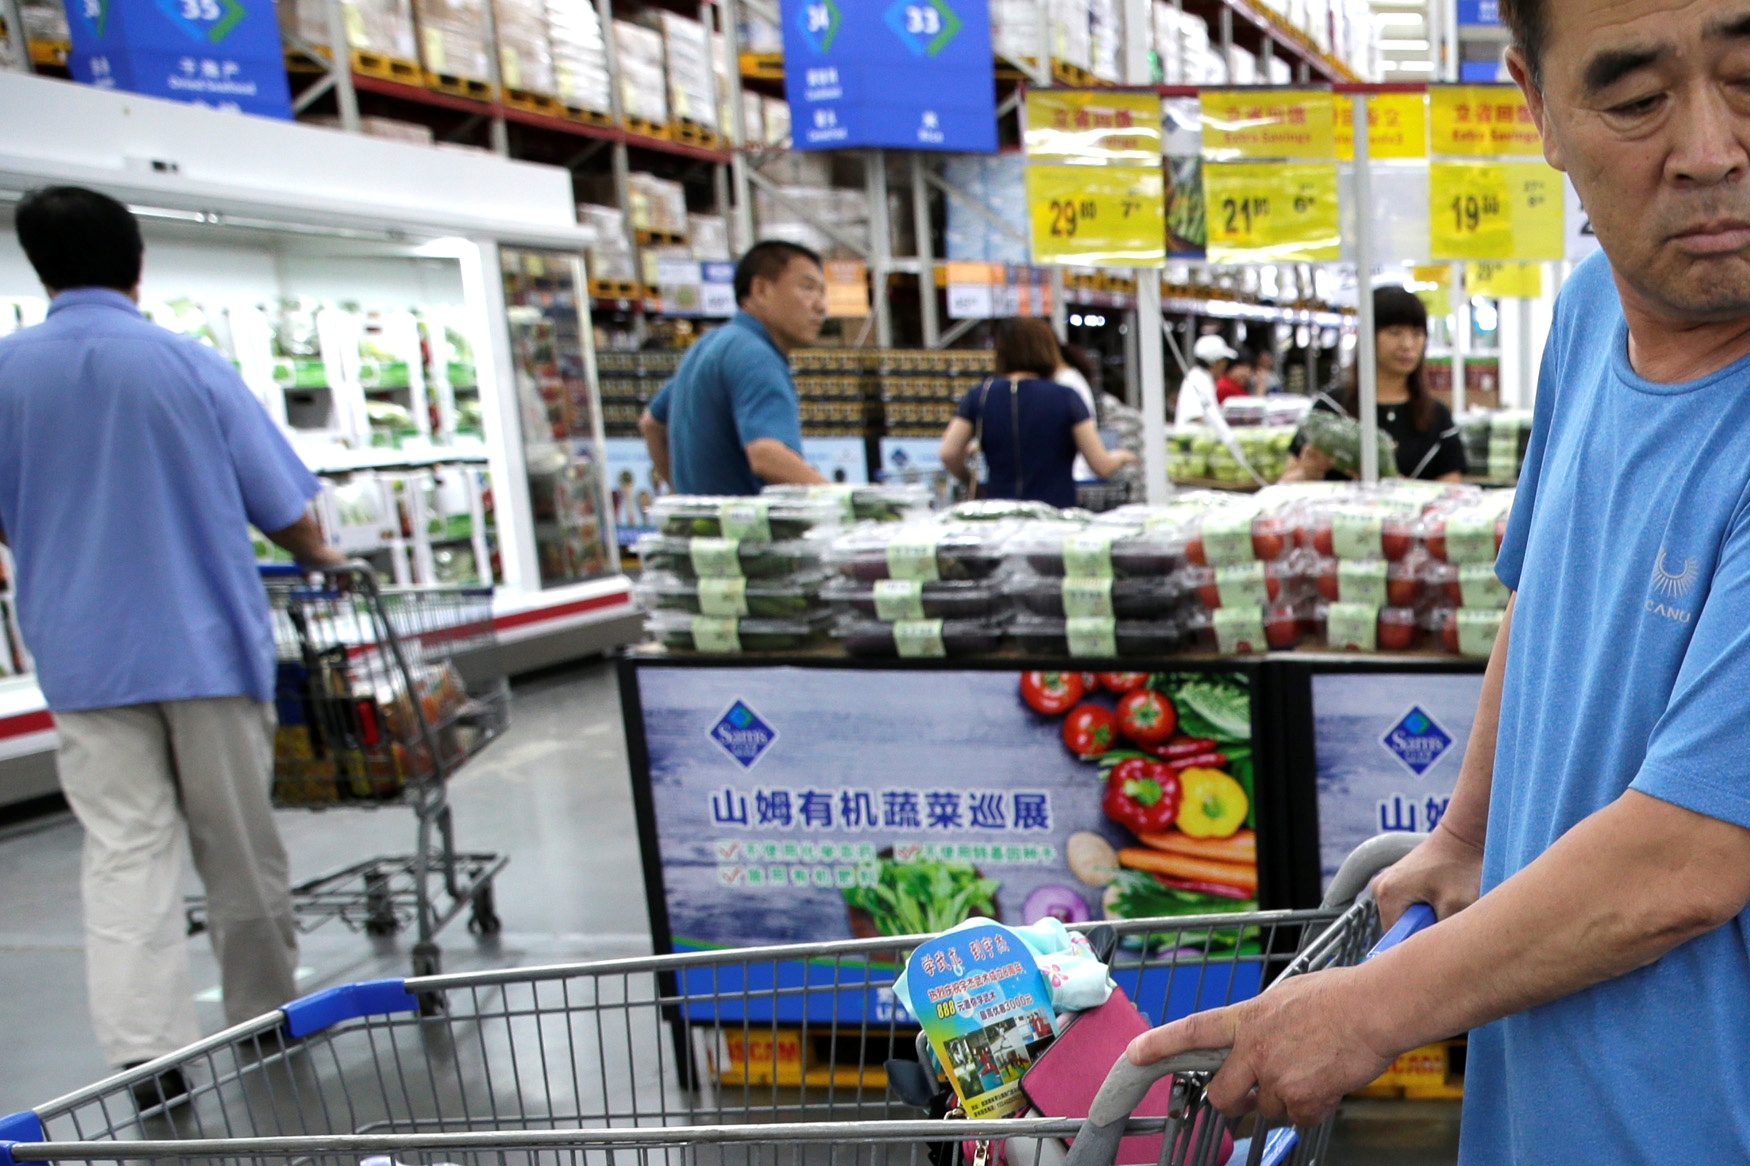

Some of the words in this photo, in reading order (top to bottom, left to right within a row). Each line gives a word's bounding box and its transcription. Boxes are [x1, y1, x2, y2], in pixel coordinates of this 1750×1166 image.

[906, 5, 940, 34] 33
[712, 788, 1051, 830] 山姆有机蔬菜巡展
